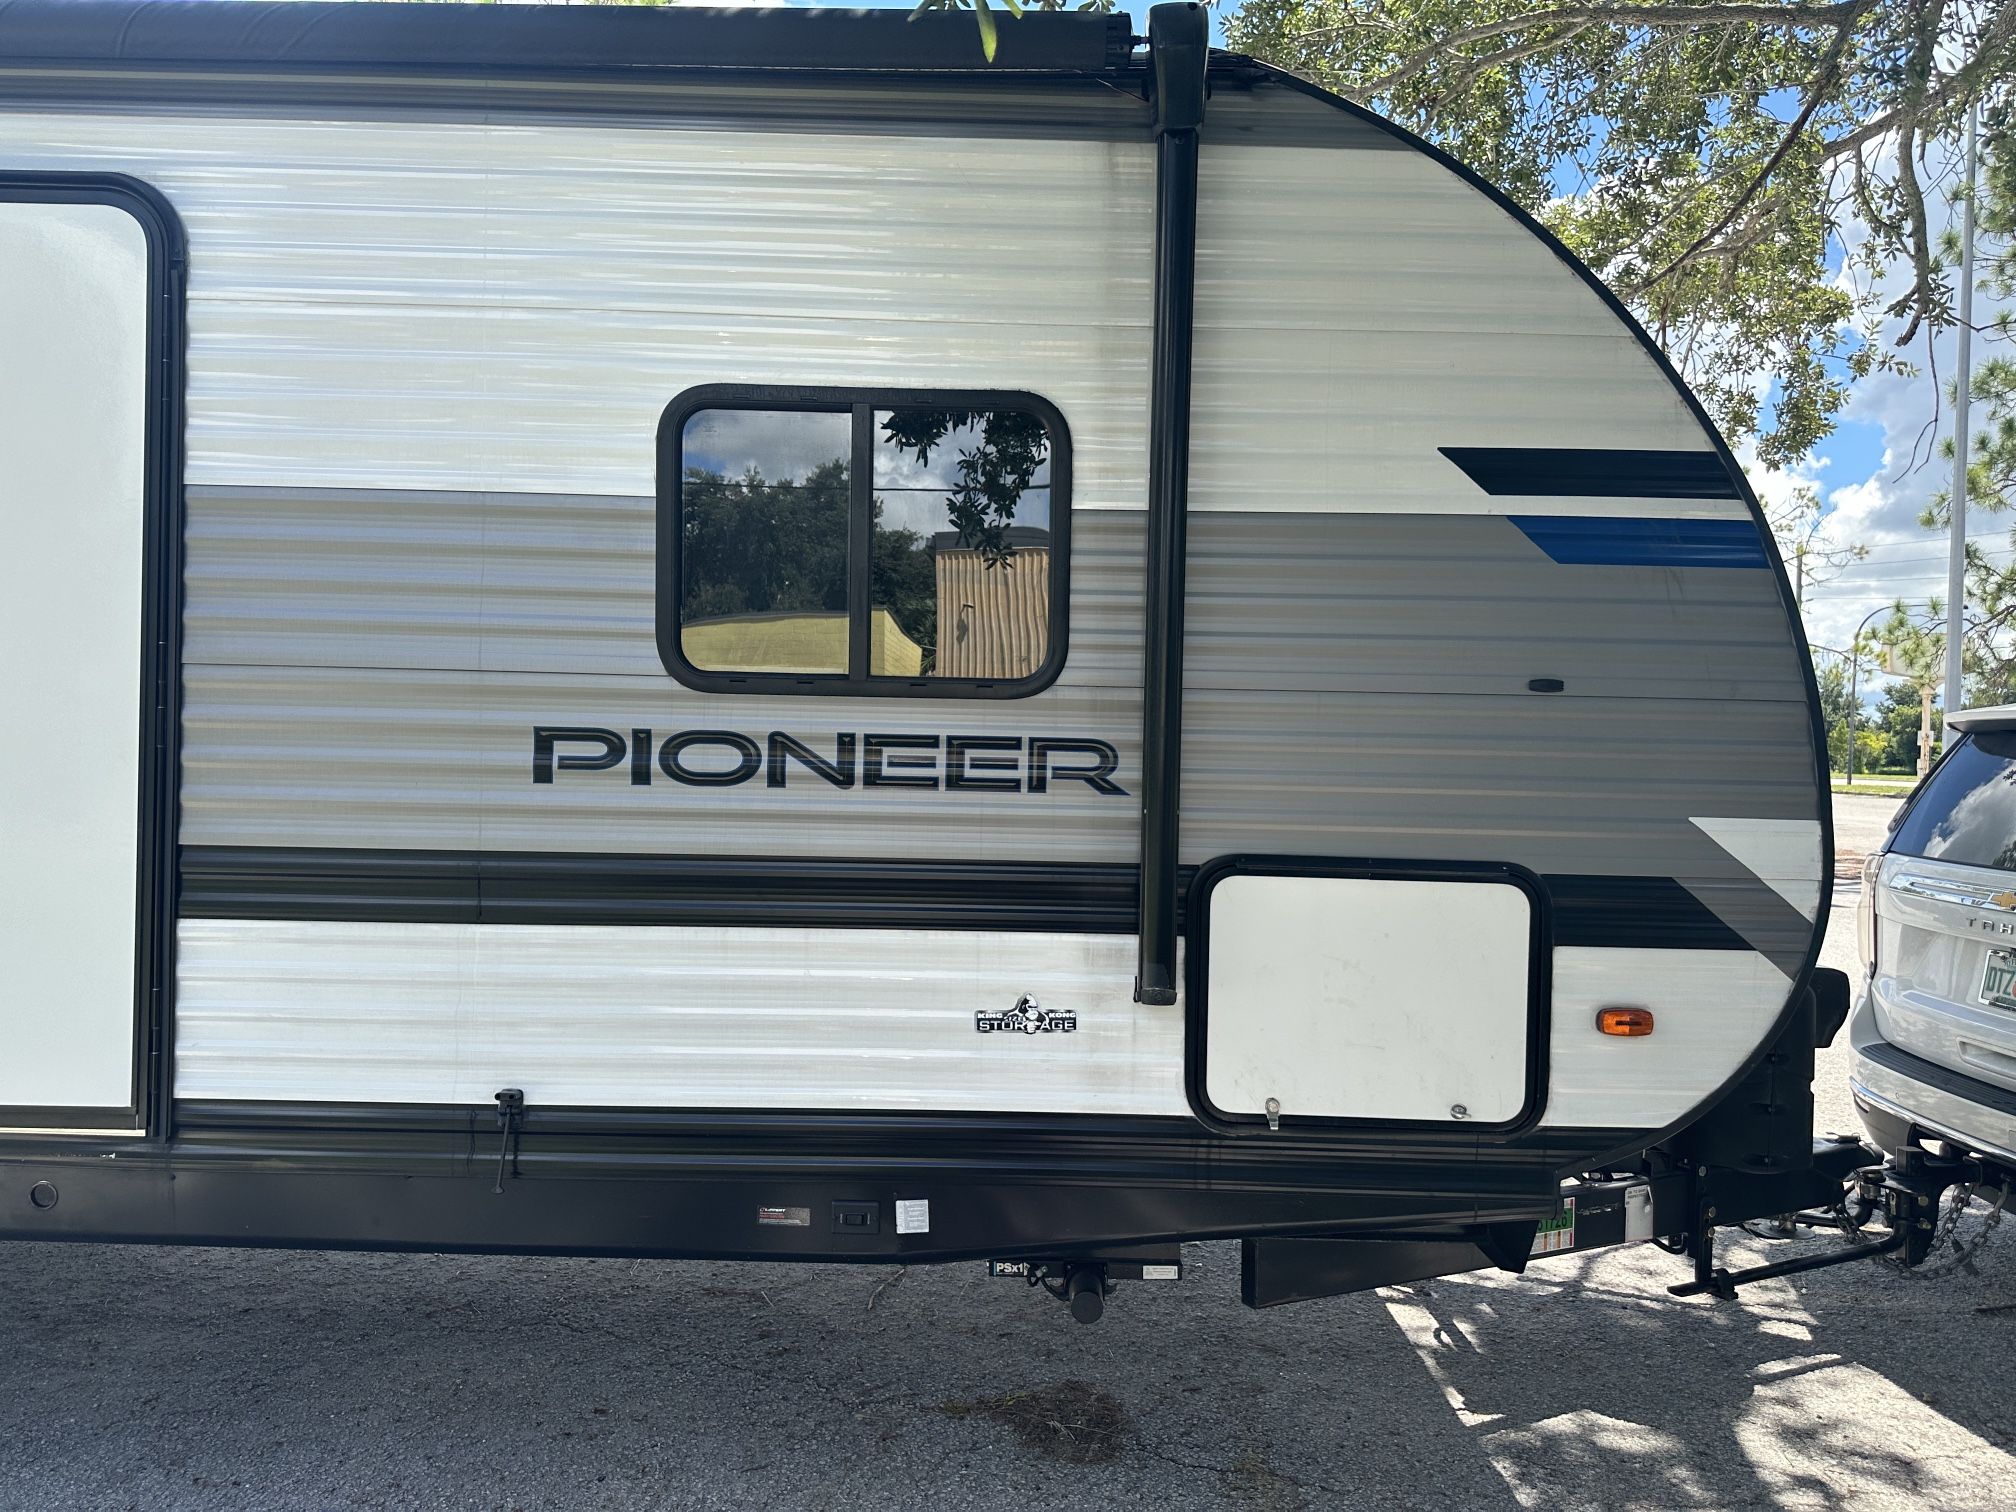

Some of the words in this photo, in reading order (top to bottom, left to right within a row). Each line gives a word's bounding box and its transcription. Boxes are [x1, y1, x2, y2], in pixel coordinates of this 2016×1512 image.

[532, 726, 1131, 796] PIONEER
[979, 1019, 1075, 1031] STORAGE
[996, 1262, 1023, 1273] PSx1
